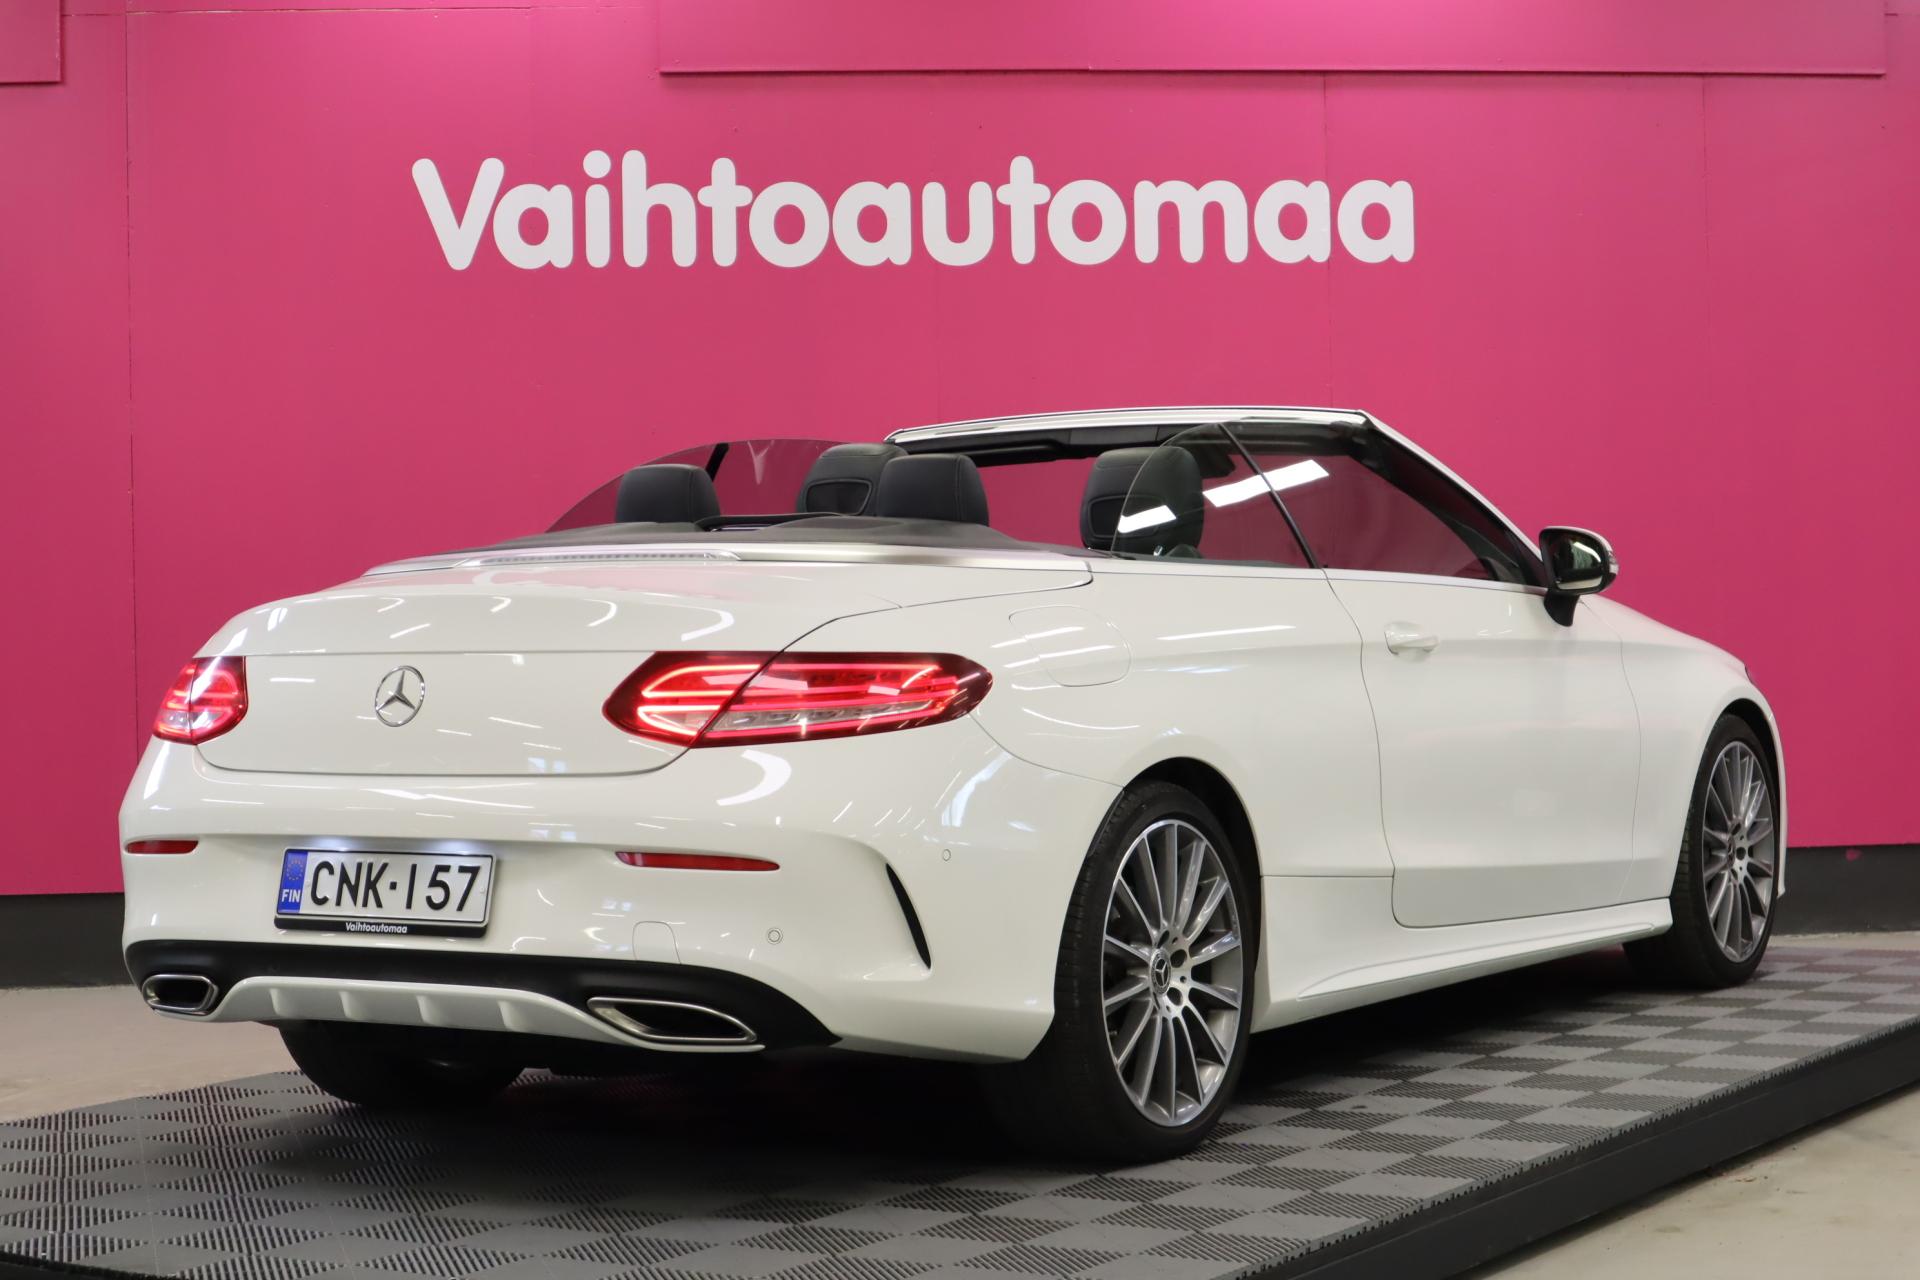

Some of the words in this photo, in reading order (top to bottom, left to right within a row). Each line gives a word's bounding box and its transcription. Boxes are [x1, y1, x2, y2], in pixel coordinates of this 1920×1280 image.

[411, 149, 1416, 271] Vaihtoautomaa
[281, 888, 301, 903] FIN
[345, 922, 408, 934] Vaihtoautomaa
